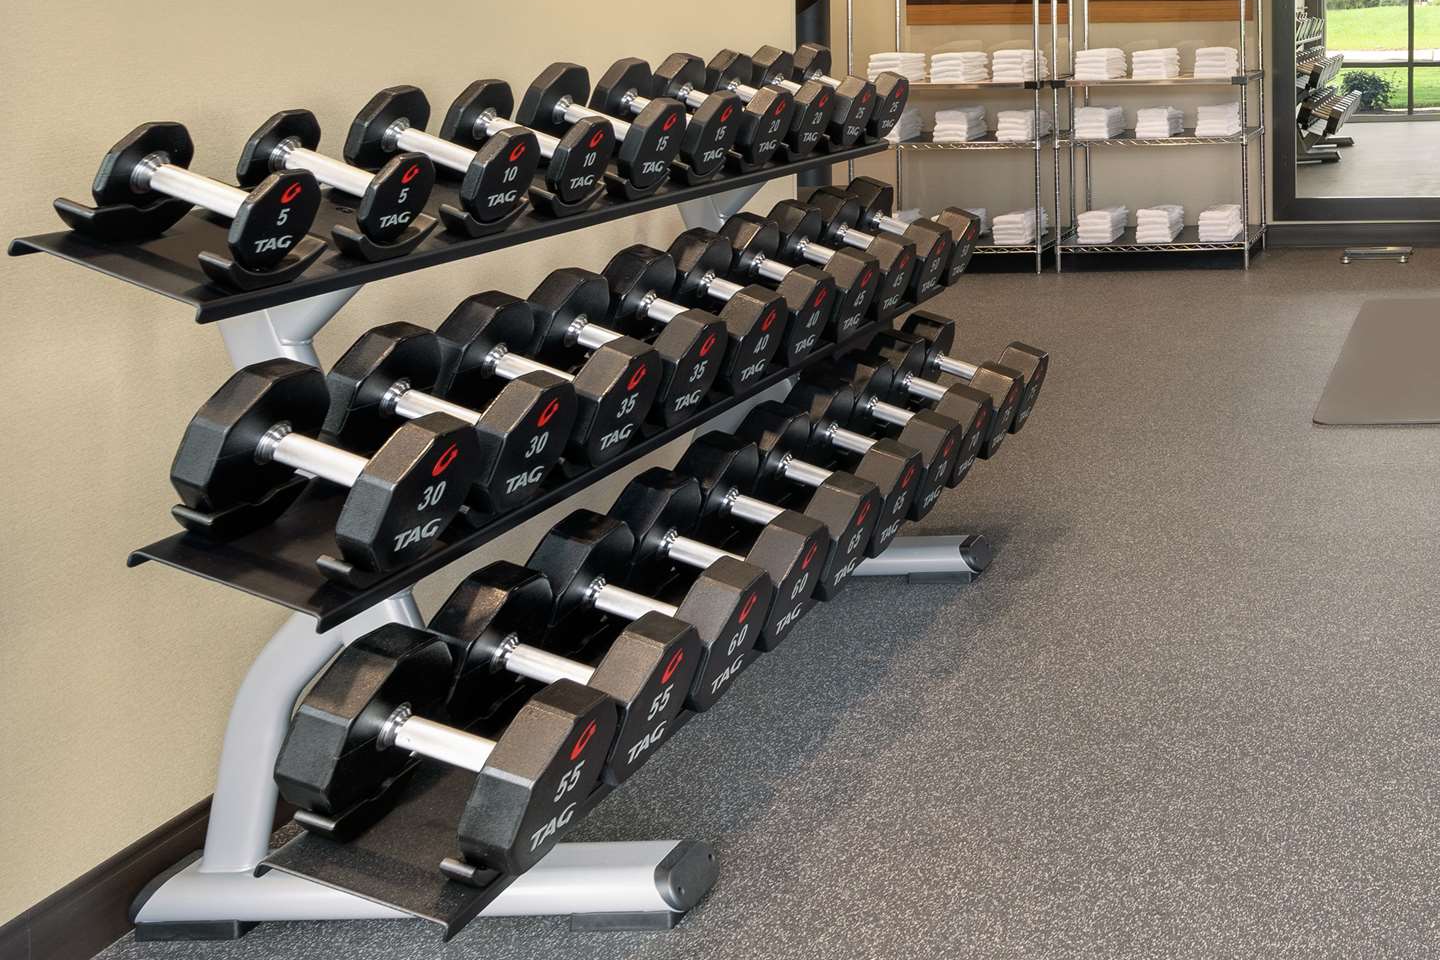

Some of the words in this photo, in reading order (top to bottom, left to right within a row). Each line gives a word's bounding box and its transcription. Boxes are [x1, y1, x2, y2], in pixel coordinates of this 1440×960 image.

[855, 107, 866, 119] 25
[889, 101, 899, 113] 25
[768, 119, 780, 134] 20
[812, 112, 823, 125] 20
[881, 118, 895, 129] TAG
[714, 126, 726, 141] 15
[802, 131, 819, 142] TAG
[846, 125, 861, 136] TAG
[655, 136, 668, 151] 15
[759, 140, 777, 153] TAG
[583, 152, 597, 168] 10
[703, 147, 724, 162] TAG
[502, 166, 518, 184] 10
[642, 160, 665, 174] TAG
[570, 174, 594, 190] TAG
[398, 187, 408, 204] 5
[487, 190, 518, 208] TAG
[276, 207, 290, 226] 5
[379, 210, 411, 229] TAG
[254, 234, 294, 253] TAG
[883, 293, 899, 311] TAG
[805, 310, 821, 328] 40
[843, 312, 861, 330] TAG
[753, 334, 770, 355] 40
[794, 334, 816, 354] TAG
[689, 360, 708, 382] 35
[740, 358, 766, 382] TAG
[616, 392, 639, 418] 35
[674, 389, 702, 412] TAG
[524, 431, 550, 460] 30
[600, 423, 634, 452] TAG
[505, 465, 544, 495] TAG
[417, 481, 446, 512] 30
[393, 517, 443, 552] TAG
[847, 528, 864, 554] 65
[879, 519, 901, 544] TAG
[834, 557, 857, 586] TAG
[790, 572, 809, 600] 60
[775, 602, 802, 635] TAG
[727, 624, 749, 656] 60
[711, 653, 746, 695] TAG
[647, 682, 675, 721] 55
[626, 719, 669, 765] TAG
[553, 759, 586, 803] 55
[530, 801, 575, 851] TAG
